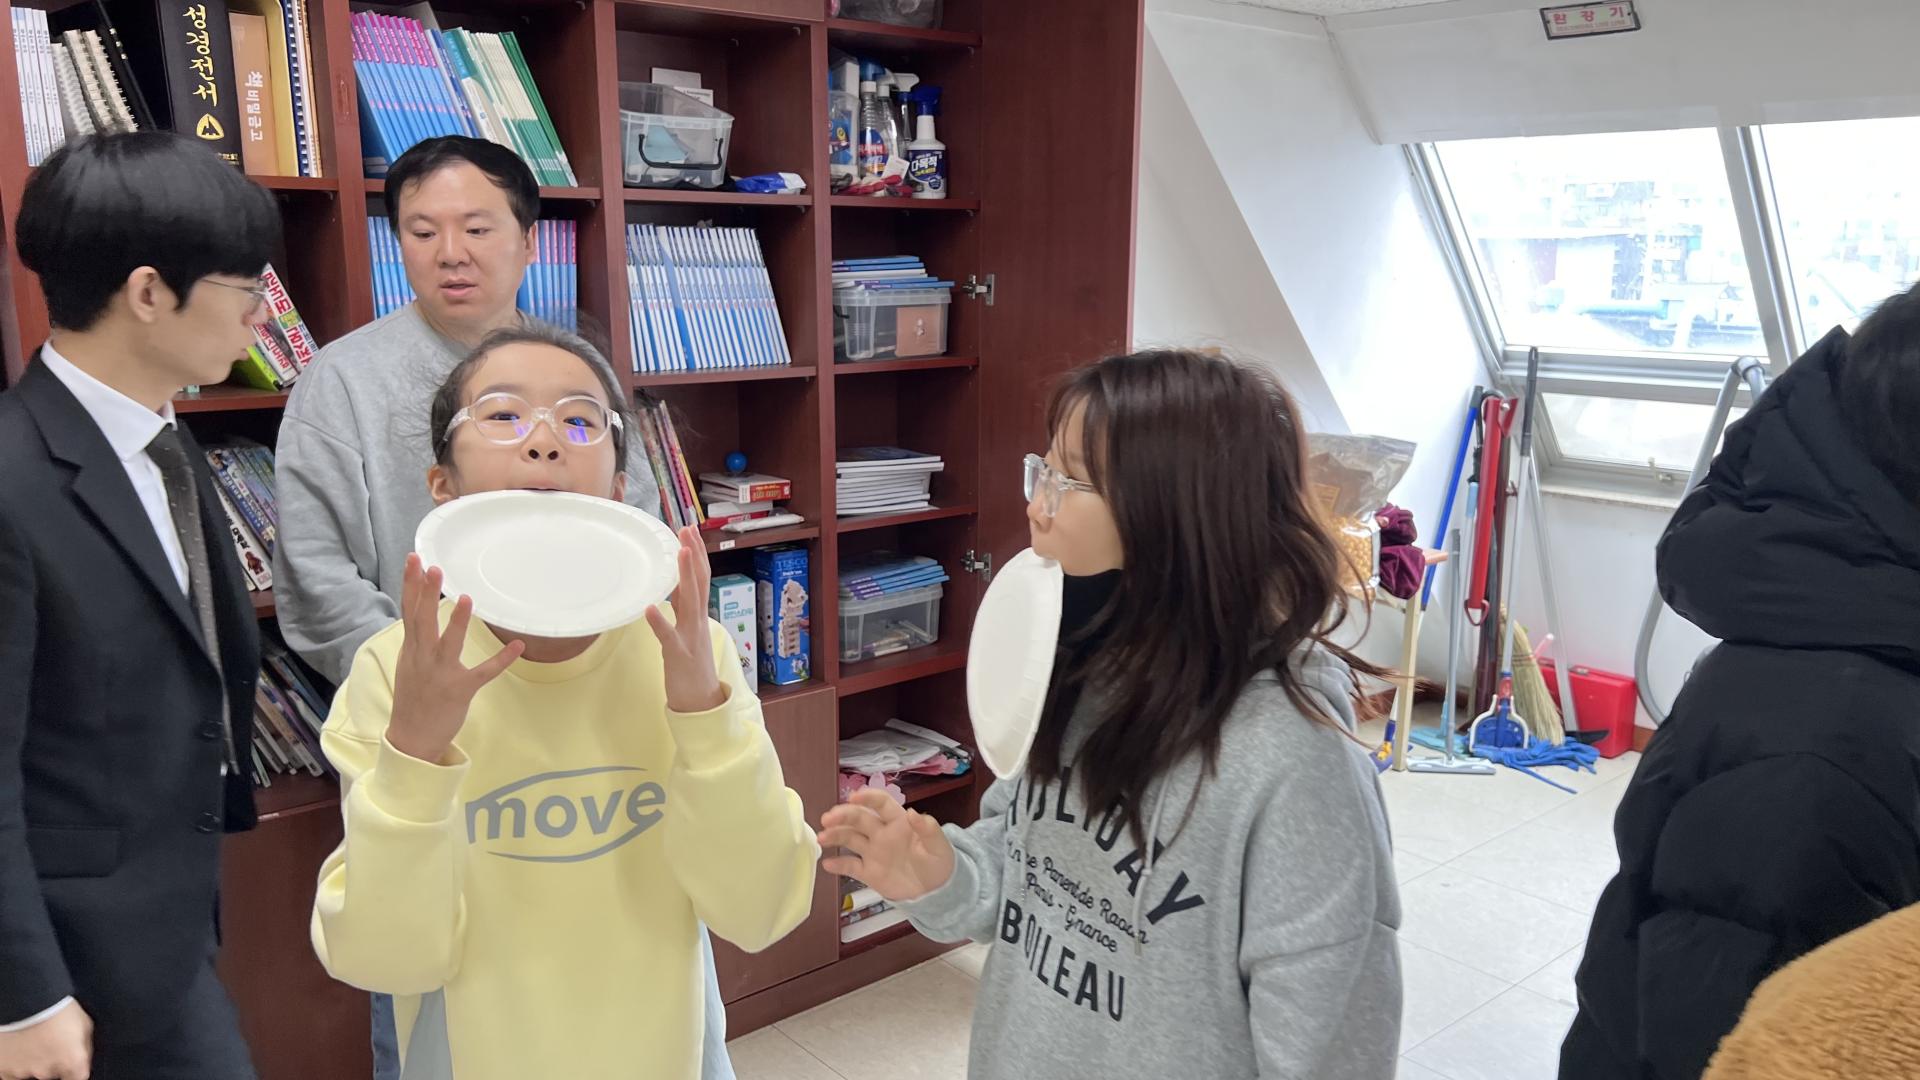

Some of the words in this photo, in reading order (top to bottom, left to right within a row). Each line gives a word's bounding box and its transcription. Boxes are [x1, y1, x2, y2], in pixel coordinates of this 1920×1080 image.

[182, 3, 218, 107] 성경전서
[244, 71, 264, 142] 책비밀금고
[464, 780, 667, 846] move
[1000, 899, 1125, 1022] BOILEAU
